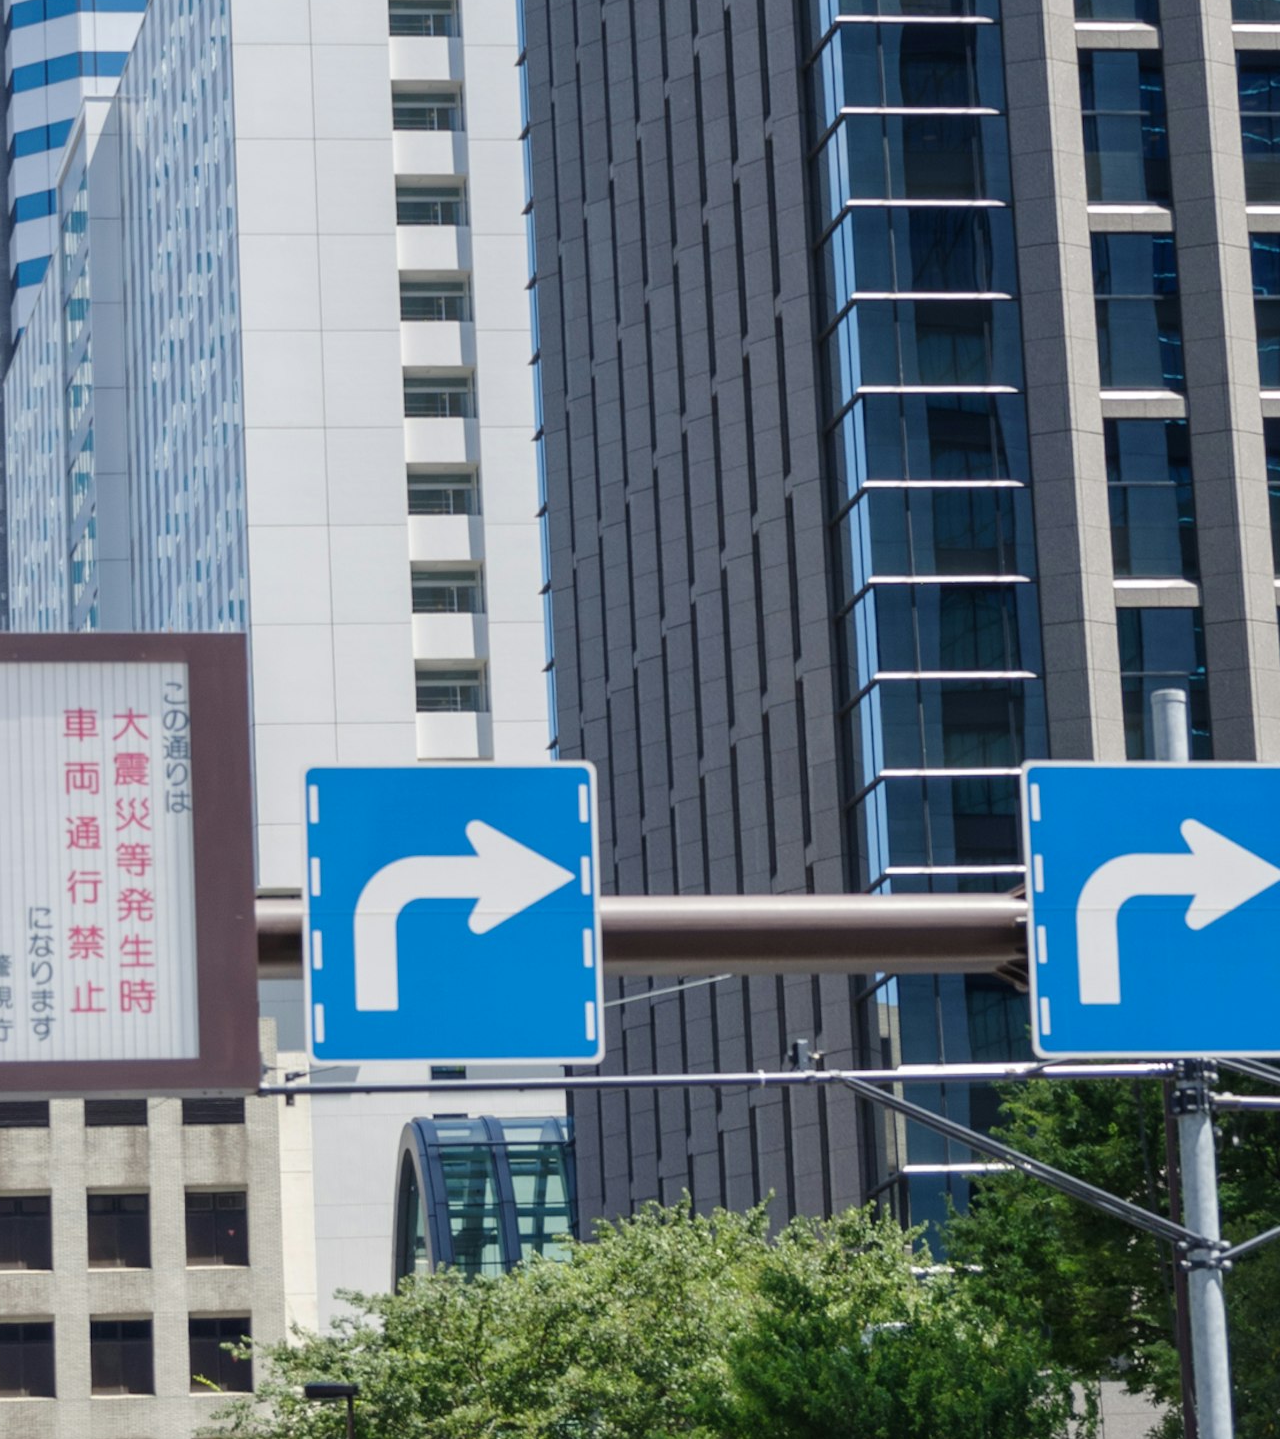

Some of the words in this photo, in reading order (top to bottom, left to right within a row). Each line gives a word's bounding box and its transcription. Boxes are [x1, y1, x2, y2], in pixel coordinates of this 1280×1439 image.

[163, 681, 192, 814] この通りは
[62, 706, 107, 1015] 車両通行禁止
[112, 706, 157, 1015] 大震災等発生時
[28, 906, 56, 1042] になります
